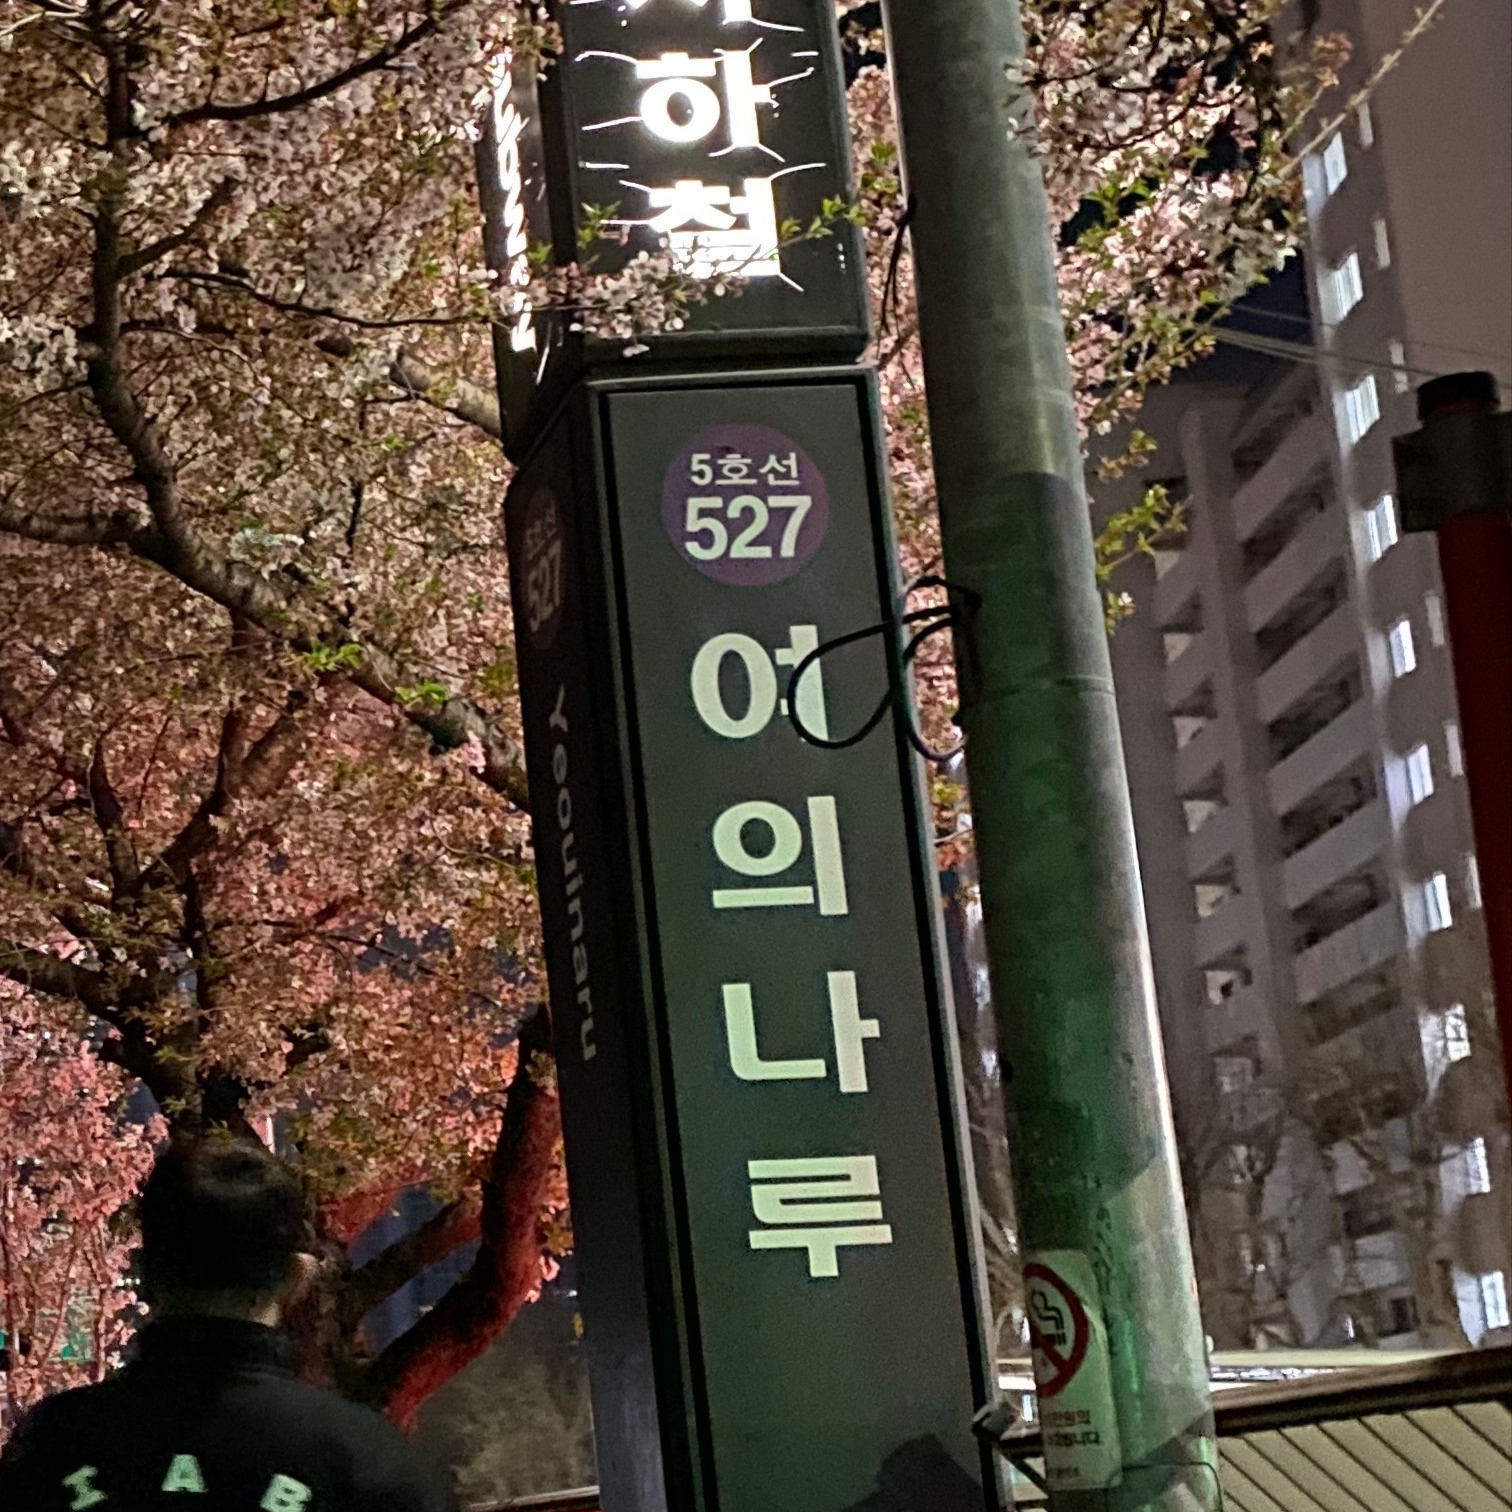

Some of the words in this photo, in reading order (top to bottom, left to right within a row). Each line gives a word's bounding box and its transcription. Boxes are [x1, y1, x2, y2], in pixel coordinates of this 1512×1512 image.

[691, 452, 801, 487] 5호선
[684, 494, 813, 561] 527
[528, 540, 562, 633] 527
[548, 684, 598, 1062] Yeouinaru
[689, 624, 892, 1278] 여의나루
